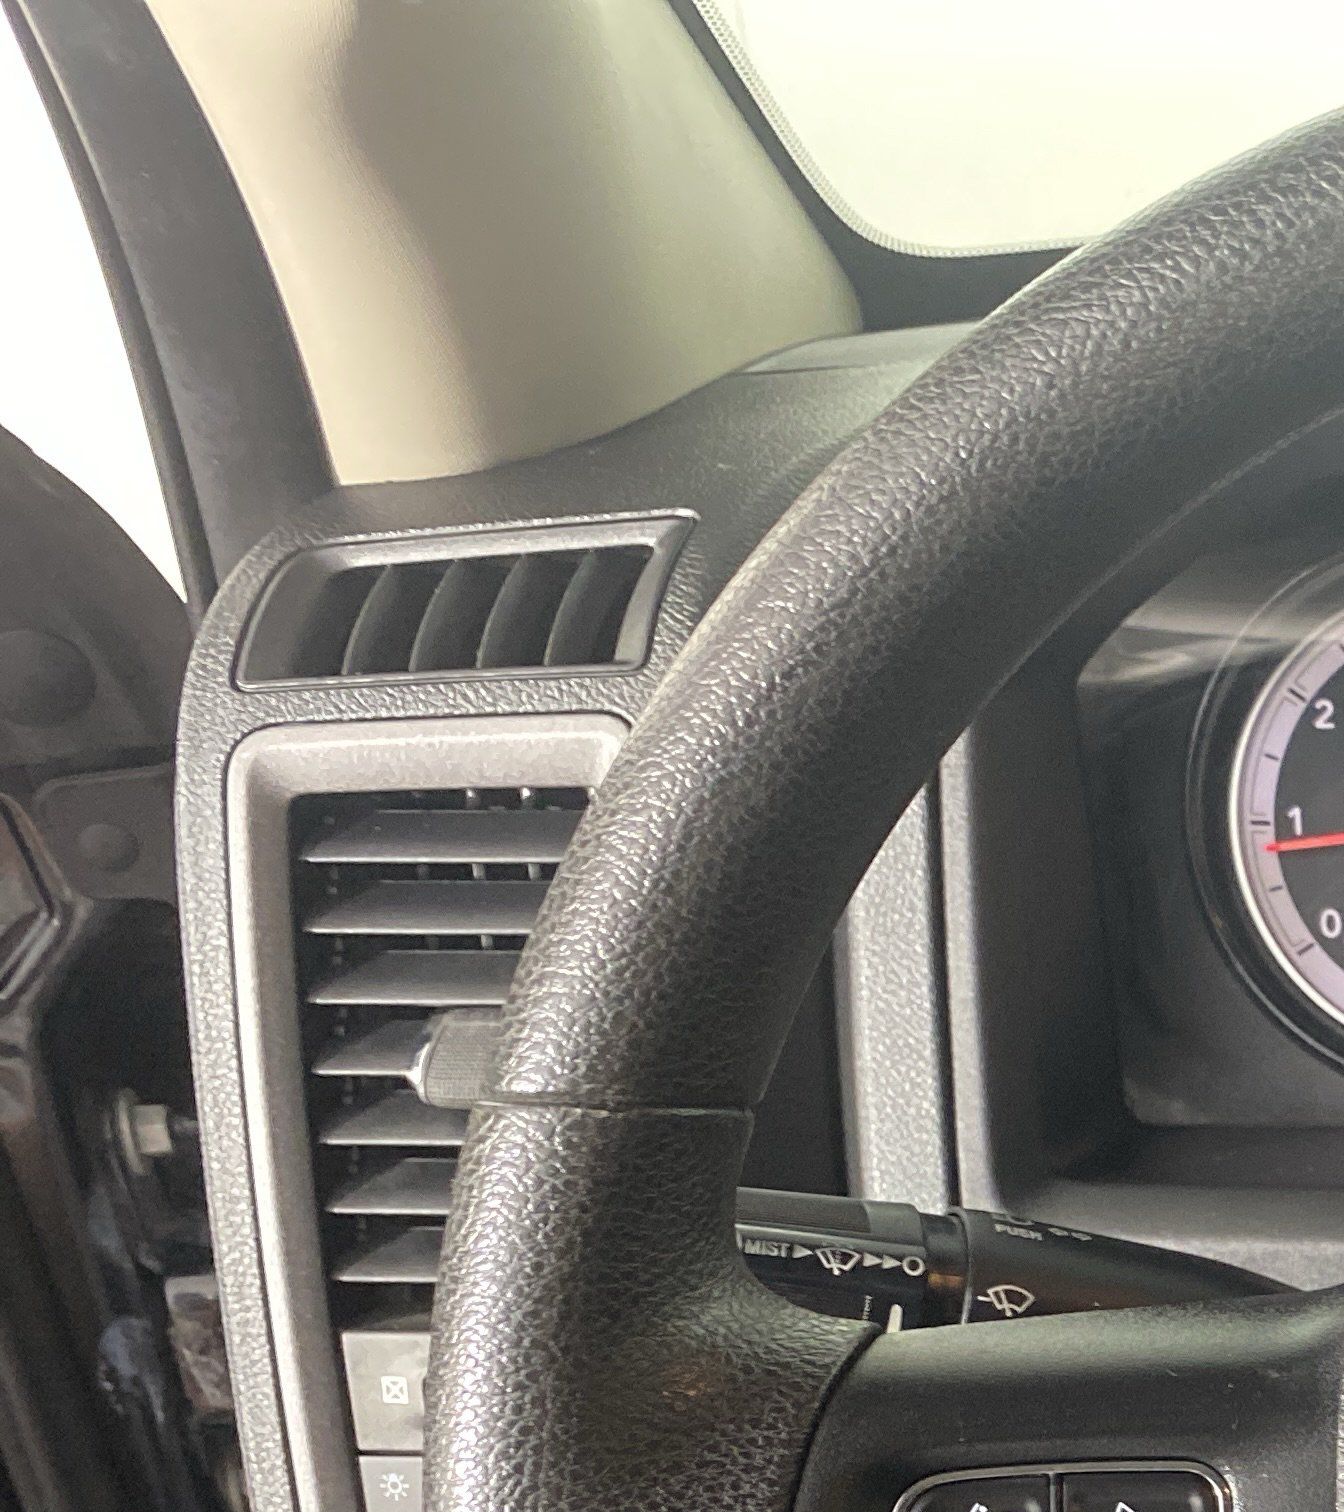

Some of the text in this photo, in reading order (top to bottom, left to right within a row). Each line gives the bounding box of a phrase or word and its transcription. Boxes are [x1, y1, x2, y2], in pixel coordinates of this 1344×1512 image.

[1314, 700, 1335, 729] 2
[1287, 807, 1302, 834] 1
[1319, 908, 1343, 939] 0
[745, 1239, 791, 1258] MIST
